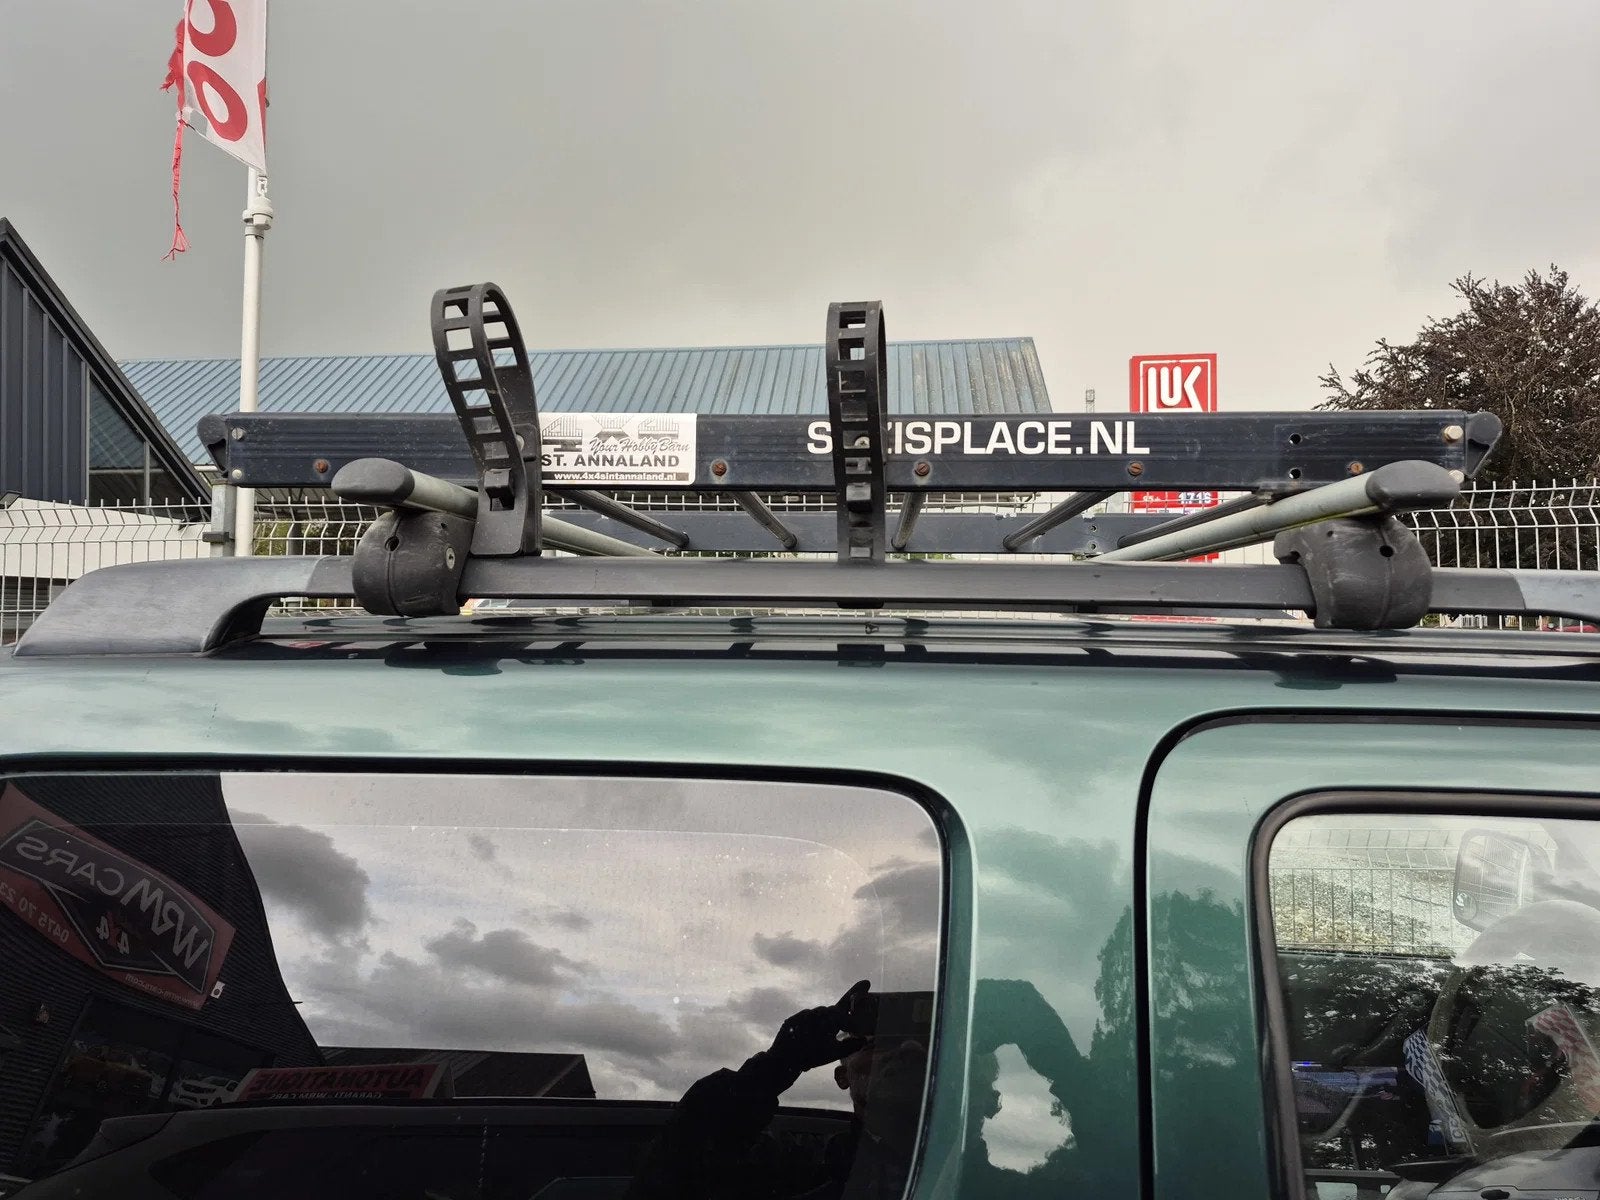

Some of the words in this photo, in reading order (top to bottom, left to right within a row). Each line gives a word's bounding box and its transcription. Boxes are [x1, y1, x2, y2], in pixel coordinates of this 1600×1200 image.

[807, 420, 1150, 456] SISPLACE.NL
[589, 438, 620, 456] Your
[618, 437, 658, 454] Hobby
[657, 438, 691, 453] Barn
[541, 454, 567, 467] ST.
[574, 454, 680, 467] ANNALAND
[554, 471, 677, 481] www.4x4sintannaland.nl
